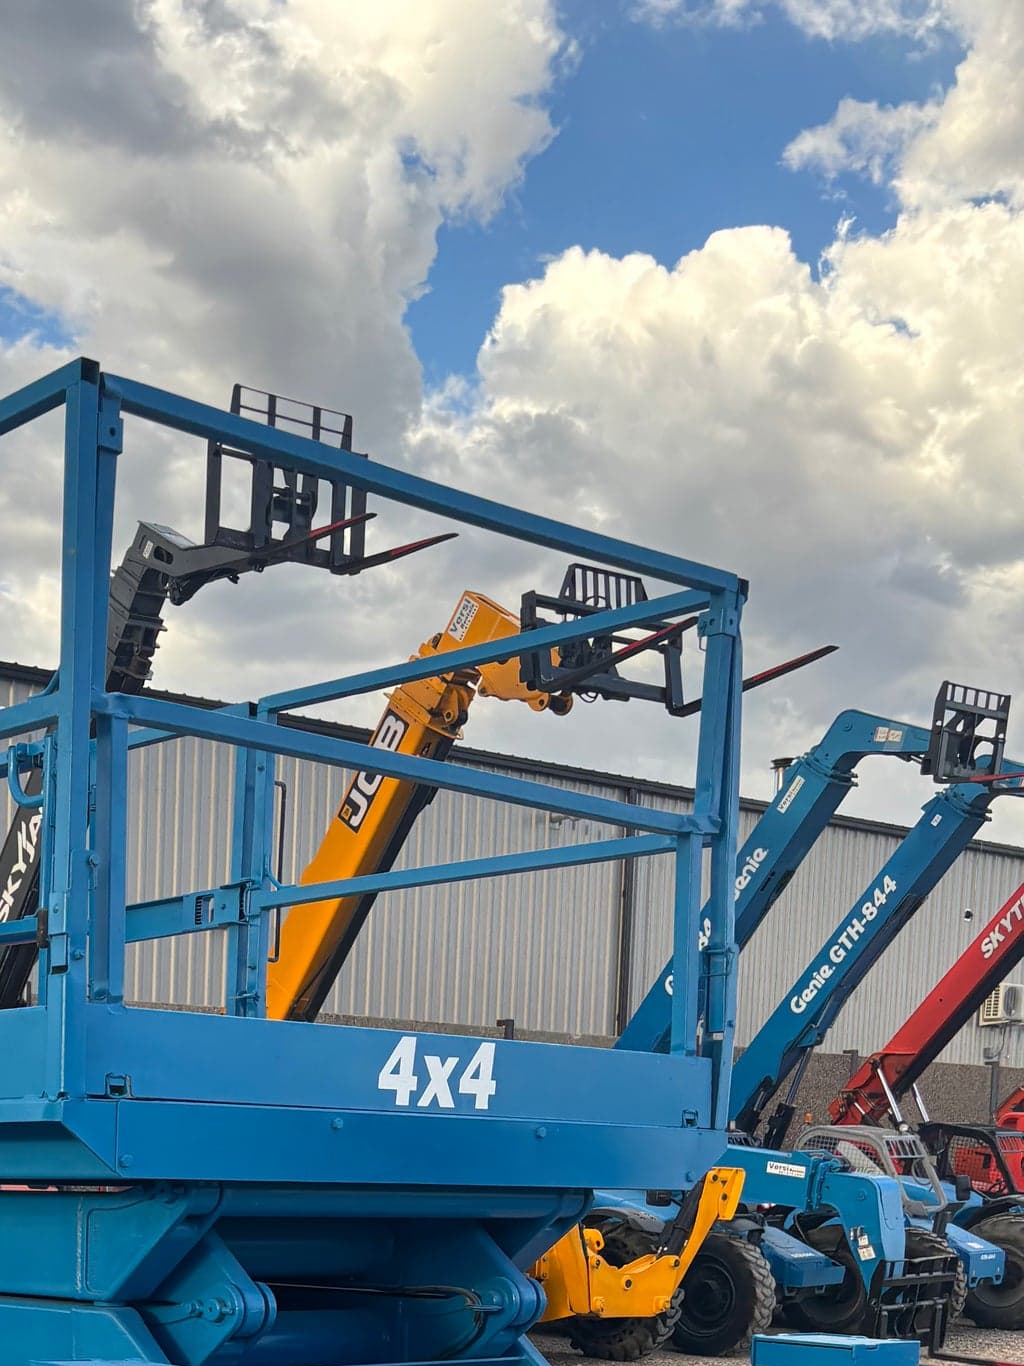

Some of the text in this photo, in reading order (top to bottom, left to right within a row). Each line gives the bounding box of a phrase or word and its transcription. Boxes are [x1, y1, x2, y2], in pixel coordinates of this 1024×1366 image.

[349, 715, 405, 827] JCB
[790, 875, 897, 1014] Genie GTH-844
[980, 893, 1024, 959] SKYT
[378, 1036, 497, 1110] 4x4
